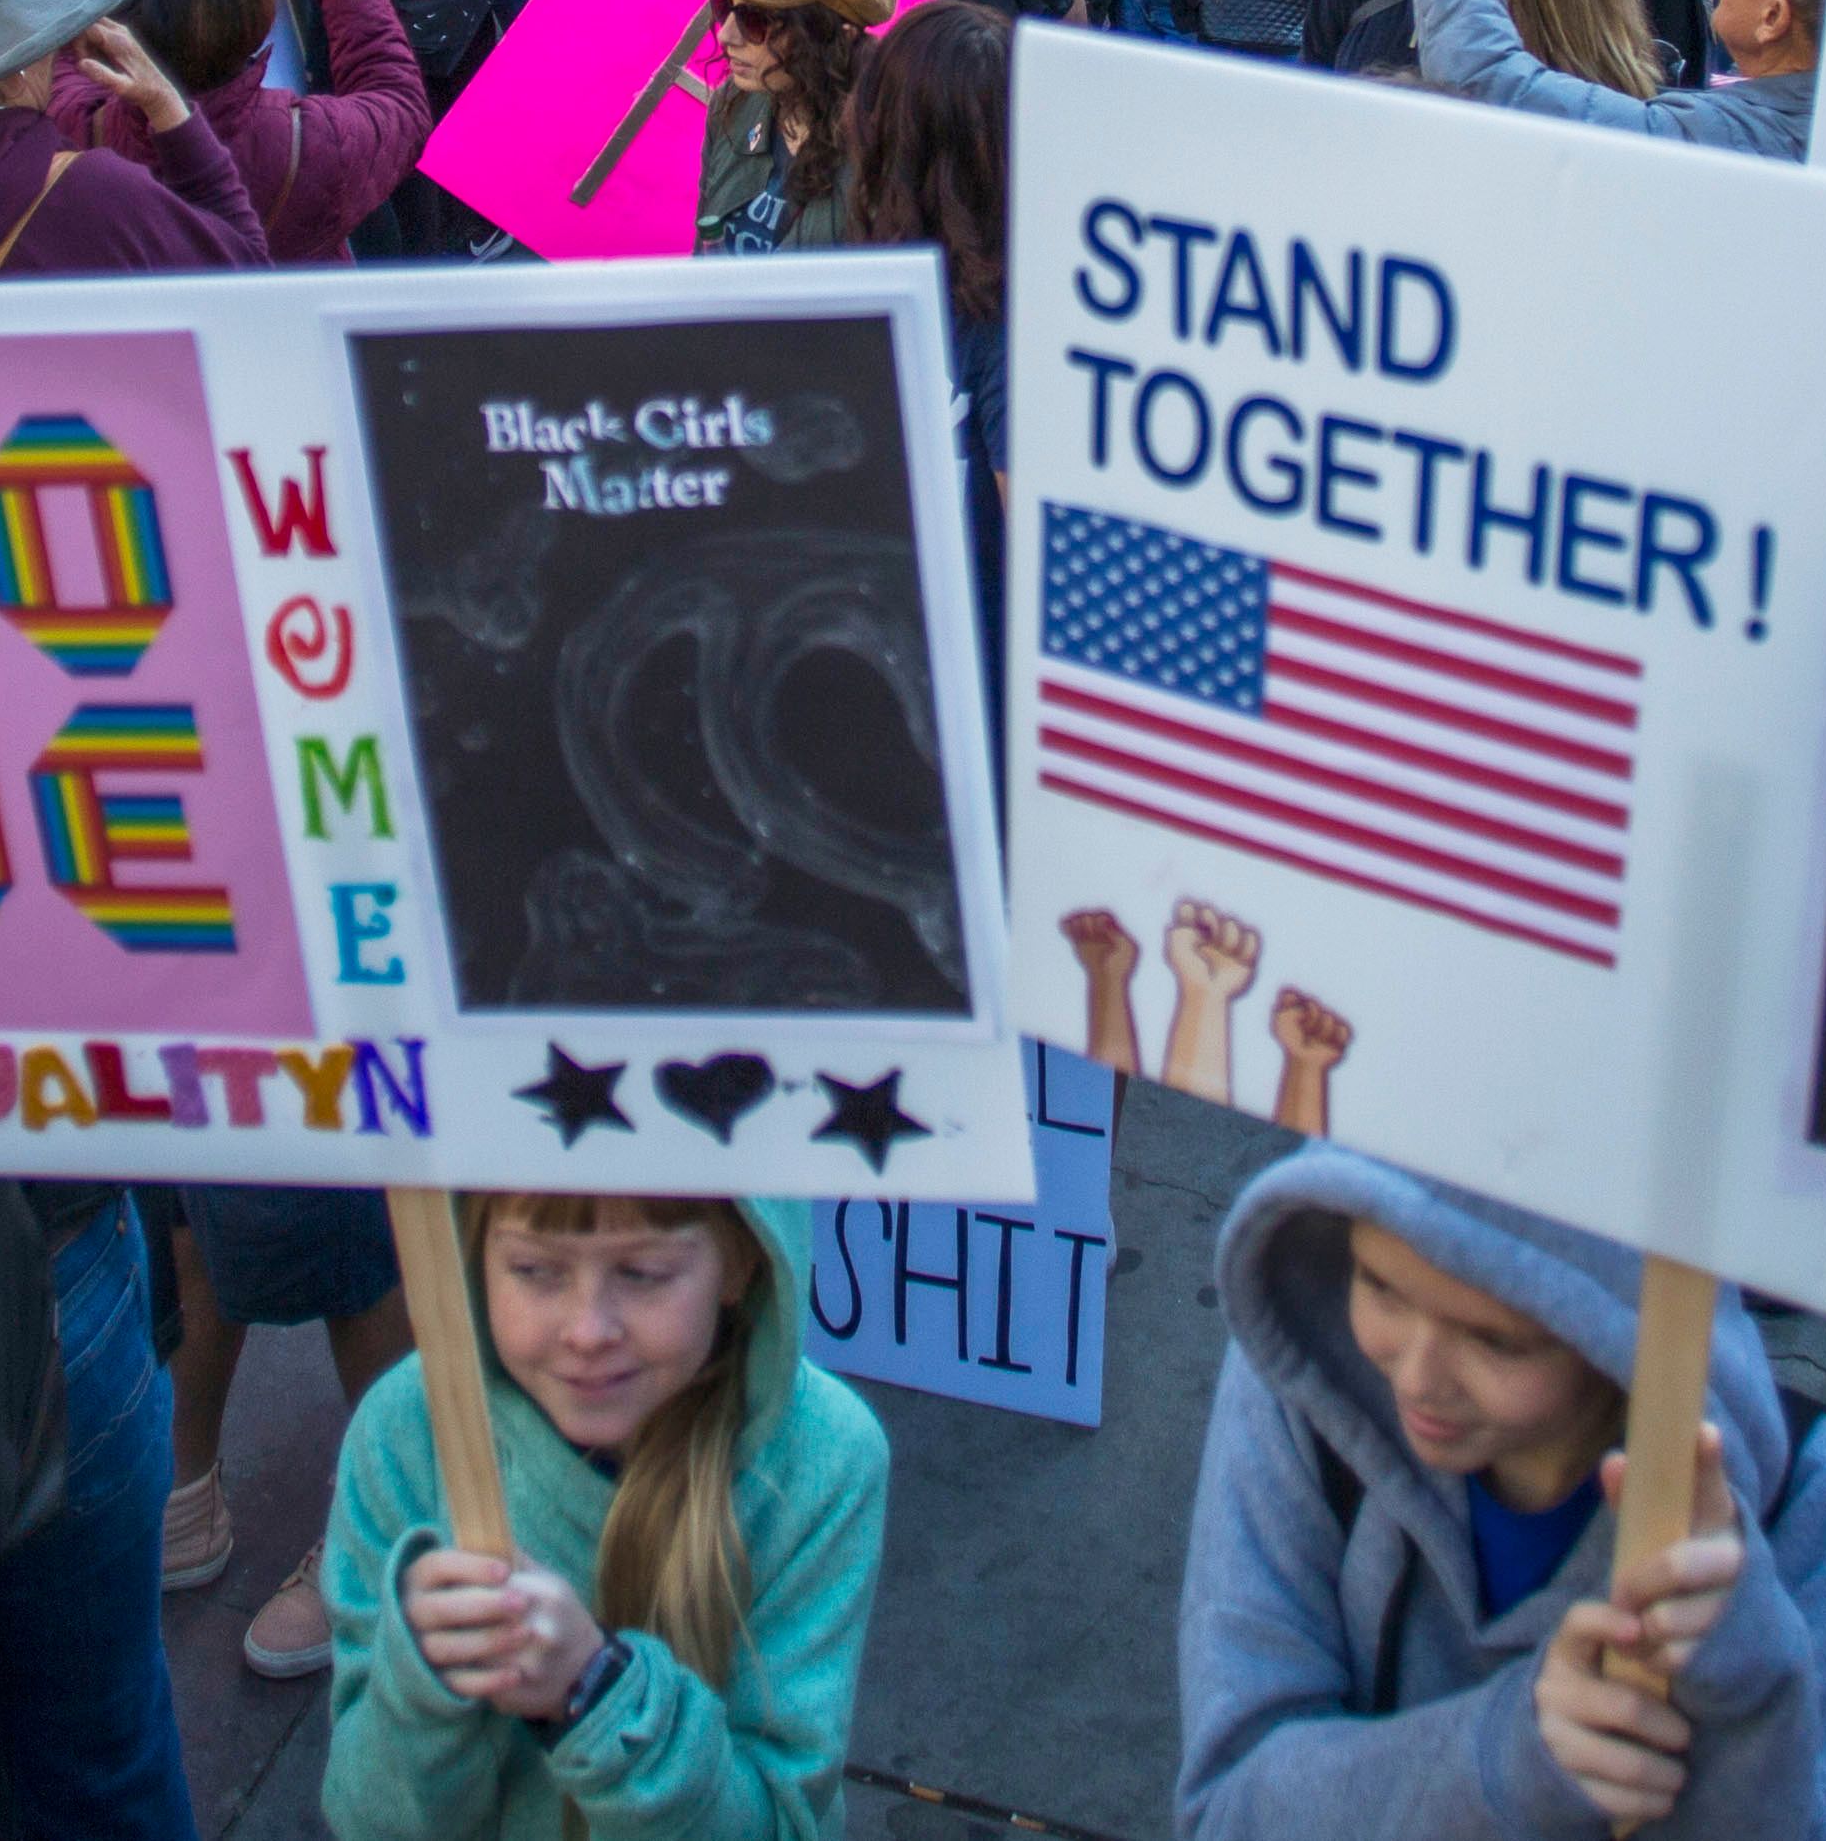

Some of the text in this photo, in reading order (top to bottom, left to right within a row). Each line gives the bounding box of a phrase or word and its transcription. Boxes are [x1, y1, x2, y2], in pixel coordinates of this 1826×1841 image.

[1075, 201, 1458, 382] STAND
[480, 394, 772, 456] Black Girls
[540, 454, 730, 515] Matter
[1070, 351, 1778, 643] TOGETHER!
[812, 1198, 1107, 1387] SHIT
